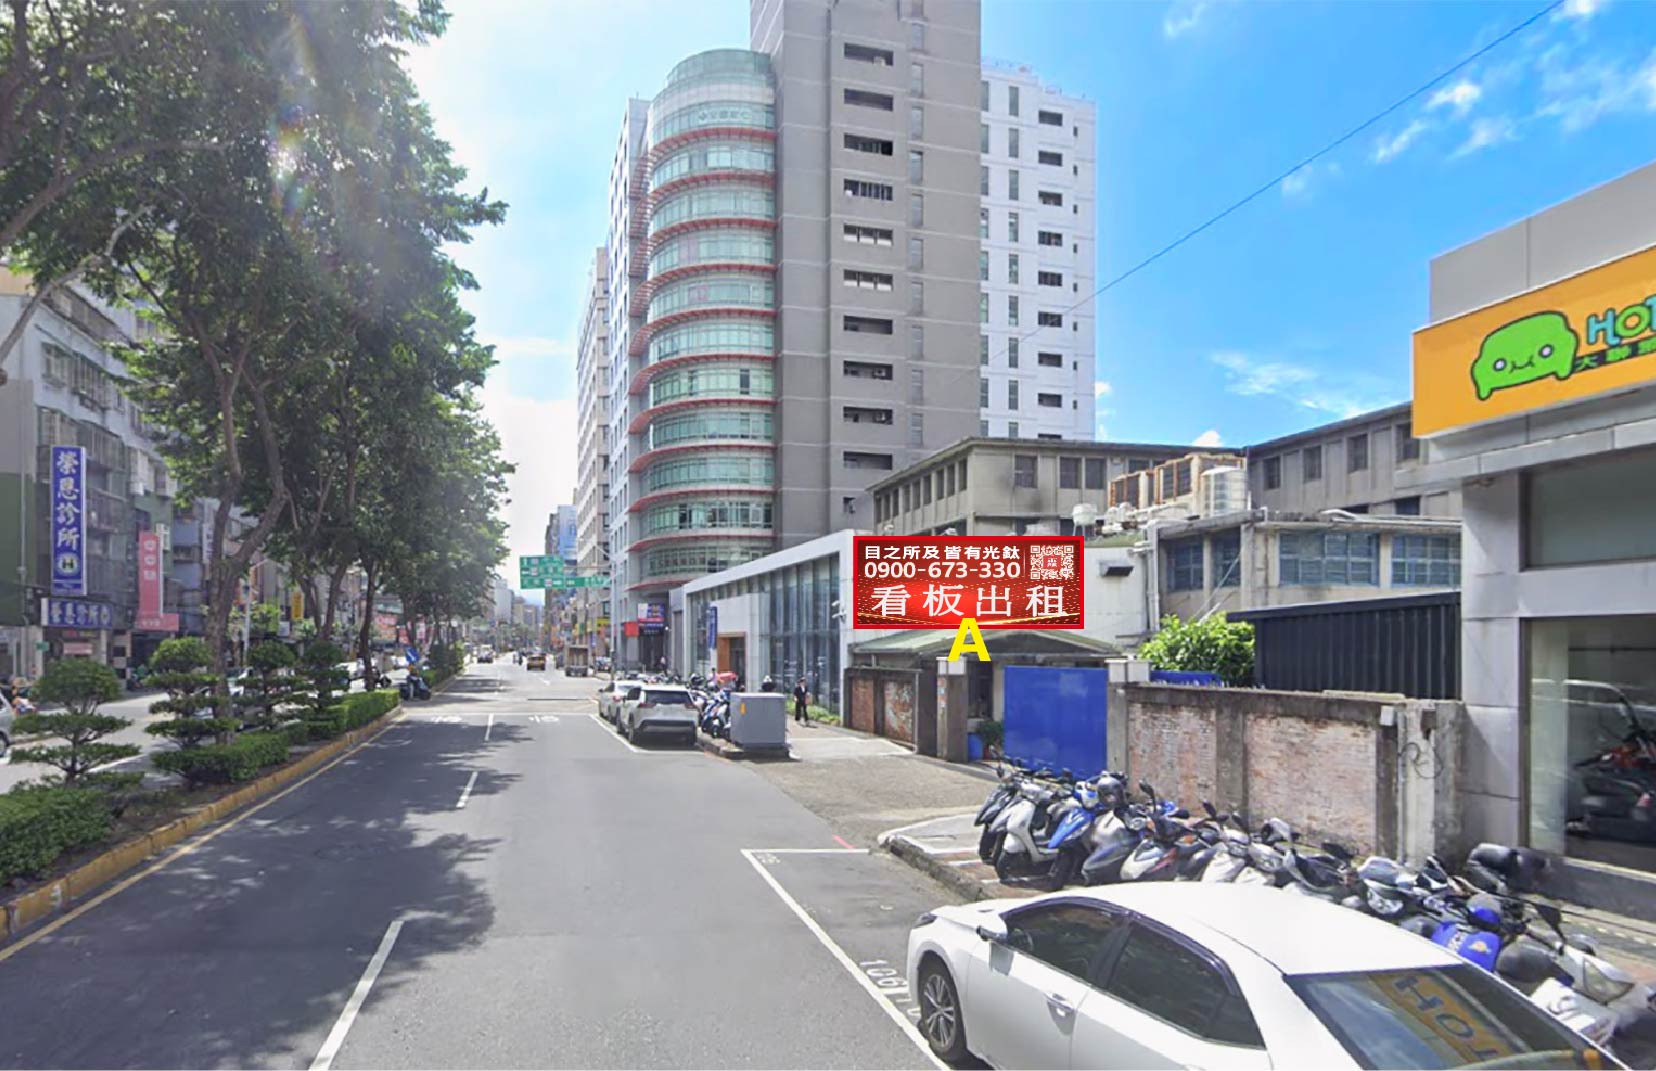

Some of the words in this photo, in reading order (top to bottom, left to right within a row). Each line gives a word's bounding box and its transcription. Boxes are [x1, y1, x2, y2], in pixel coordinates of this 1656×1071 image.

[864, 545, 1020, 560] 目之所及皆有光鈦
[864, 561, 1021, 579] 0900-673-330
[870, 583, 1068, 617] 看板出租
